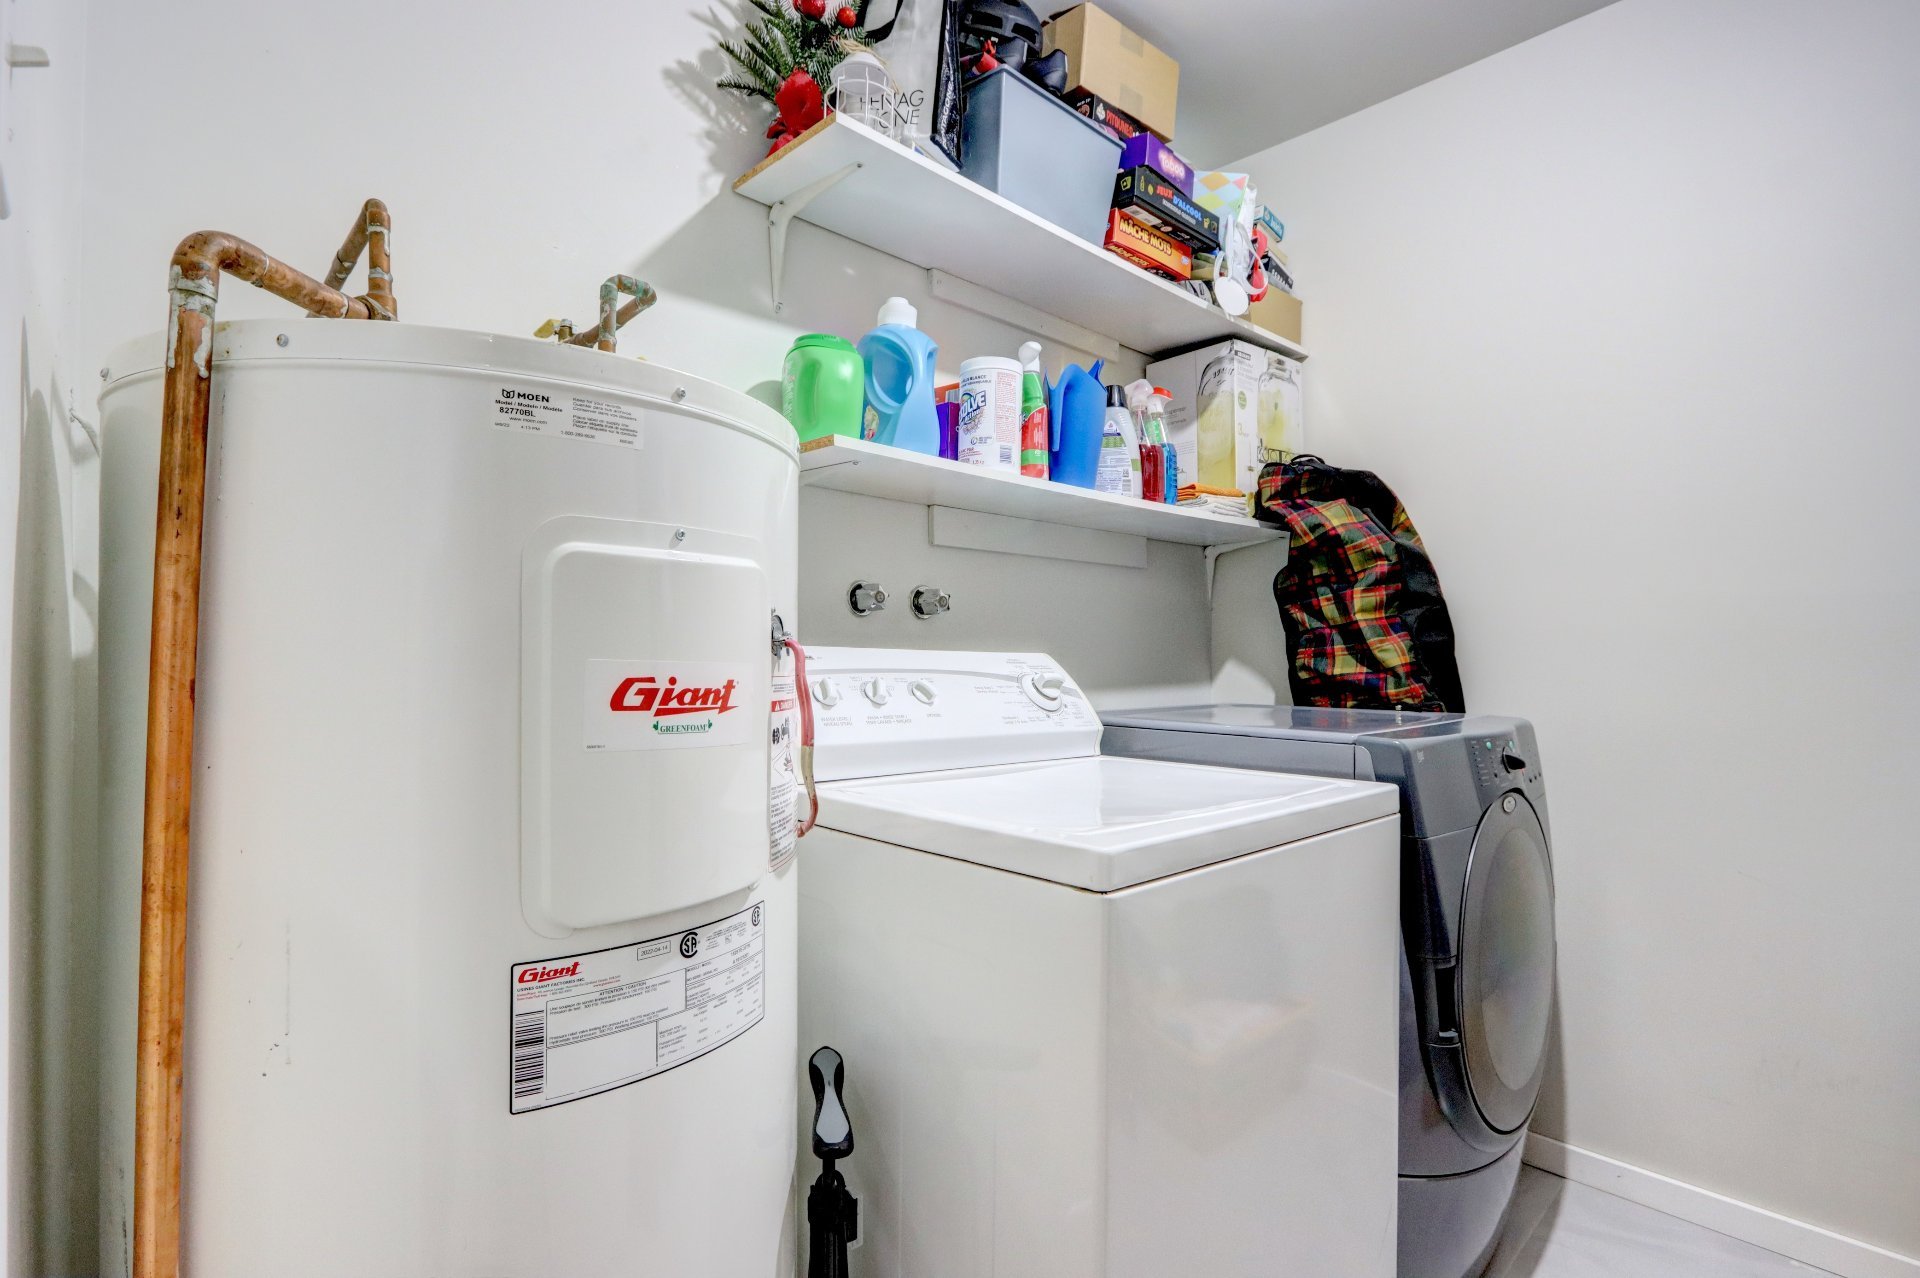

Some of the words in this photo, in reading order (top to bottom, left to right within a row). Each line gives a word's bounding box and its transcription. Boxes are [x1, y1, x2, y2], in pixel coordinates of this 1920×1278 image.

[1156, 185, 1174, 199] JEUX
[1173, 195, 1202, 221] D'ALCOOL
[1119, 217, 1150, 244] MÂCHE
[1149, 232, 1173, 256] MOTS
[517, 392, 550, 403] MOEN
[499, 407, 536, 418] 82770BL
[609, 676, 740, 717] Giant
[660, 723, 707, 733] GREENFOAM
[518, 961, 582, 985] Giant
